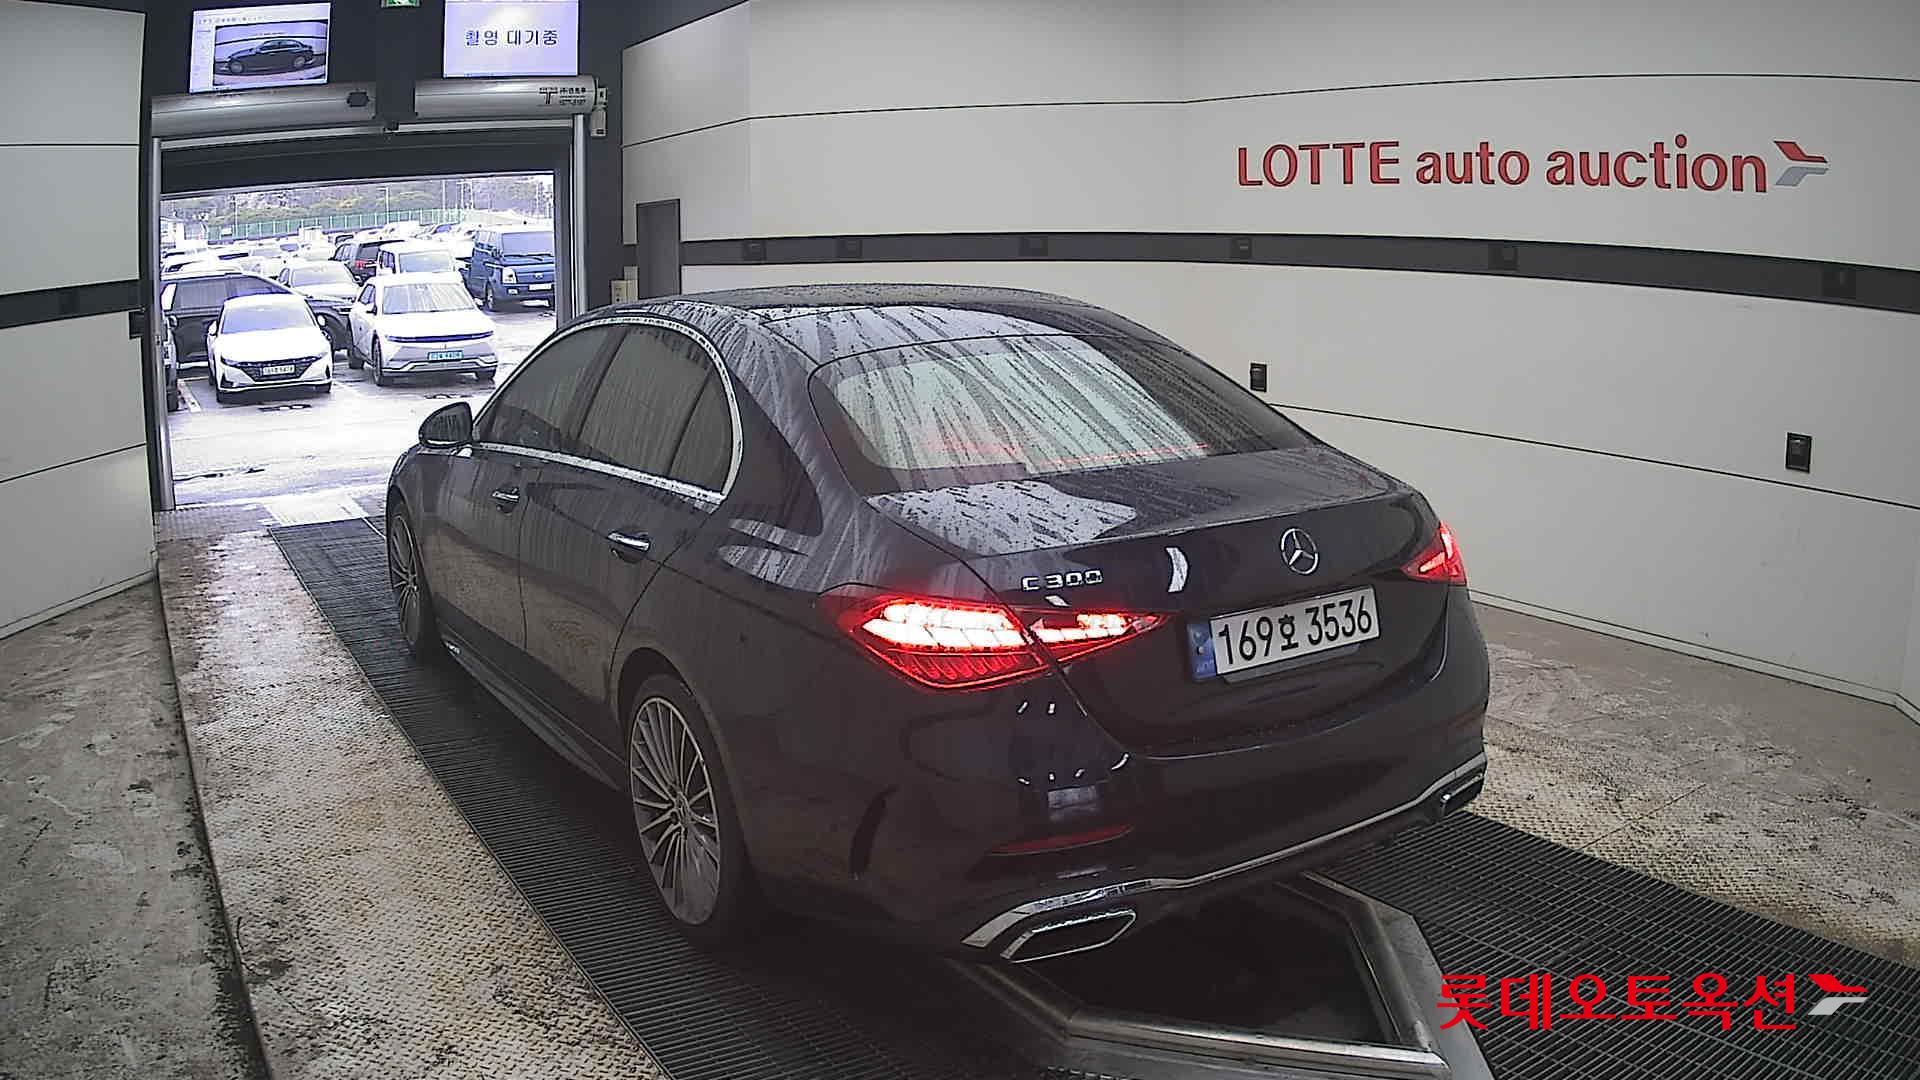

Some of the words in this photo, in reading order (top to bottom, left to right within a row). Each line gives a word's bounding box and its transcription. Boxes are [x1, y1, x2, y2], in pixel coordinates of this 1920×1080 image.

[507, 30, 558, 46] 대기중
[1238, 141, 1400, 187] LOTTE
[1415, 141, 1530, 186] auto
[1546, 134, 1768, 193] auction
[1022, 576, 1041, 591] C
[1047, 570, 1104, 589] 300
[1219, 614, 1299, 664] 169호
[1305, 596, 1372, 646] 3536
